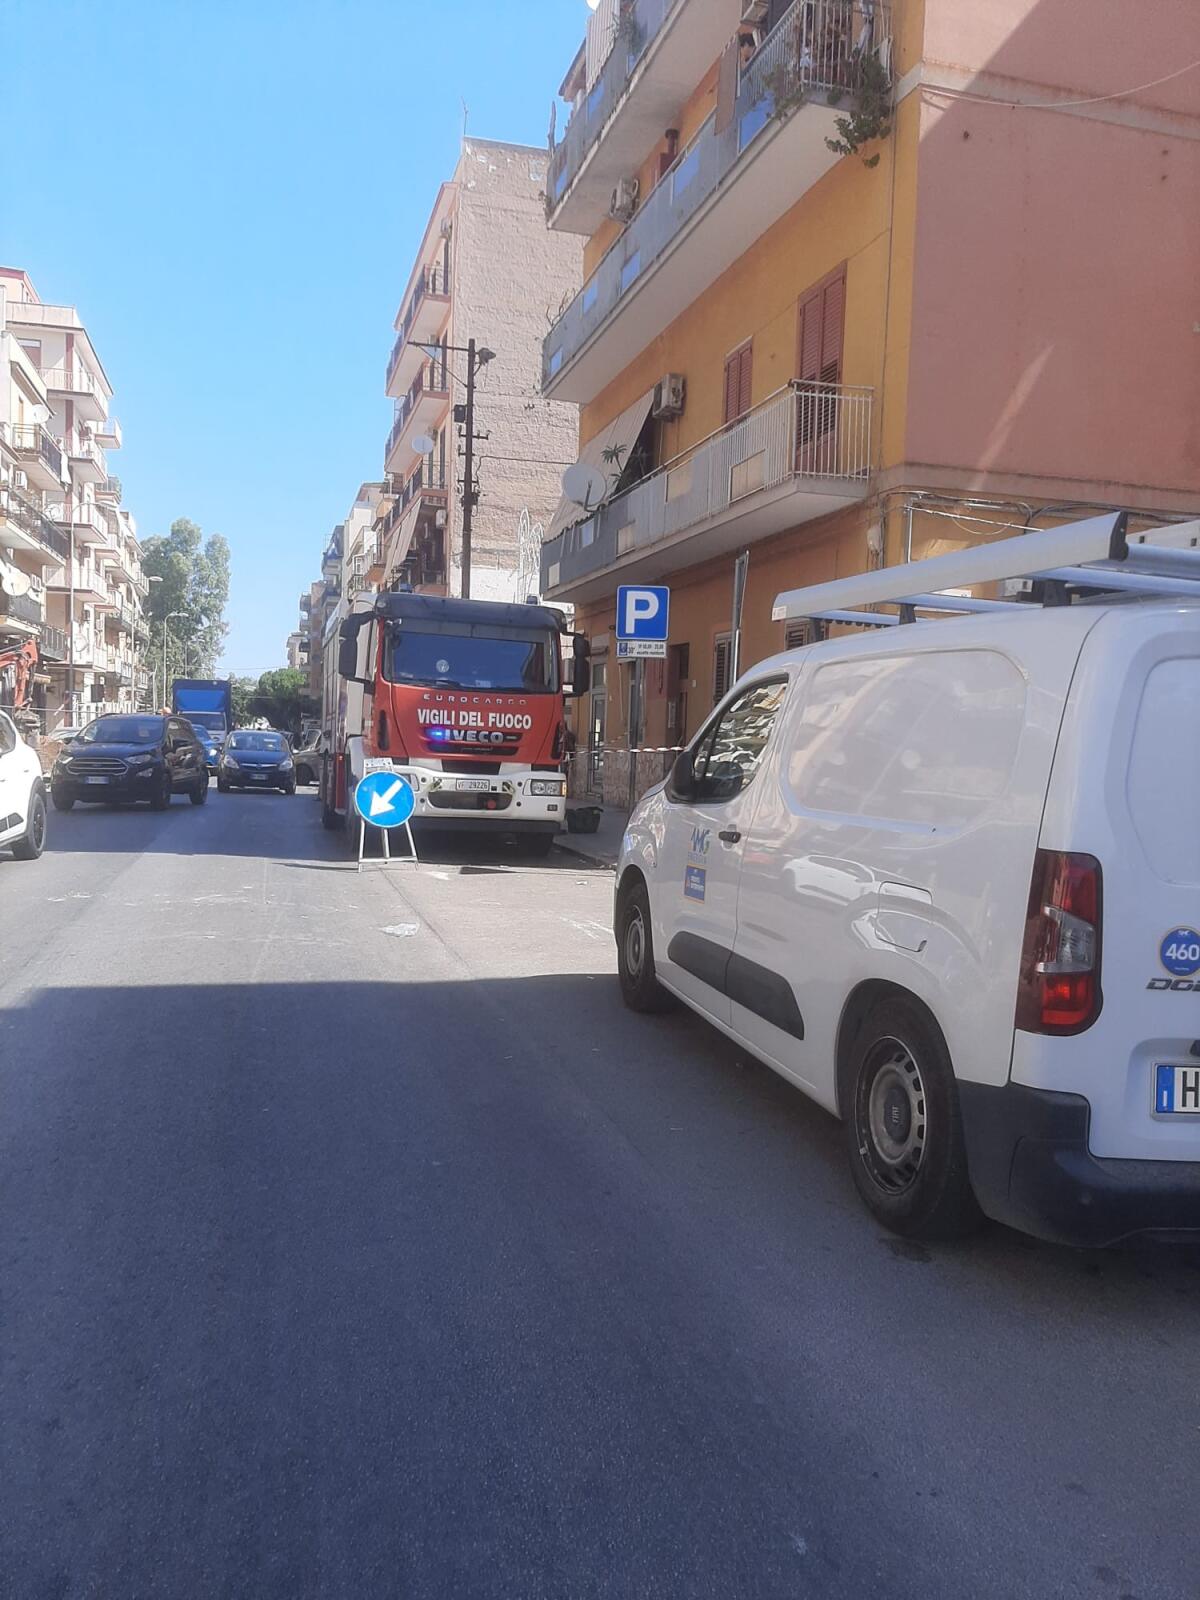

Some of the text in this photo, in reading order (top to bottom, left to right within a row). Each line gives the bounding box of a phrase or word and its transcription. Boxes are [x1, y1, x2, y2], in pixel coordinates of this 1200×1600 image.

[625, 590, 659, 634] P
[423, 693, 527, 705] EUROCARGO
[417, 708, 532, 729] VIGILI DEL FUOCO
[444, 729, 504, 743] IVECO
[1165, 943, 1200, 961] 460
